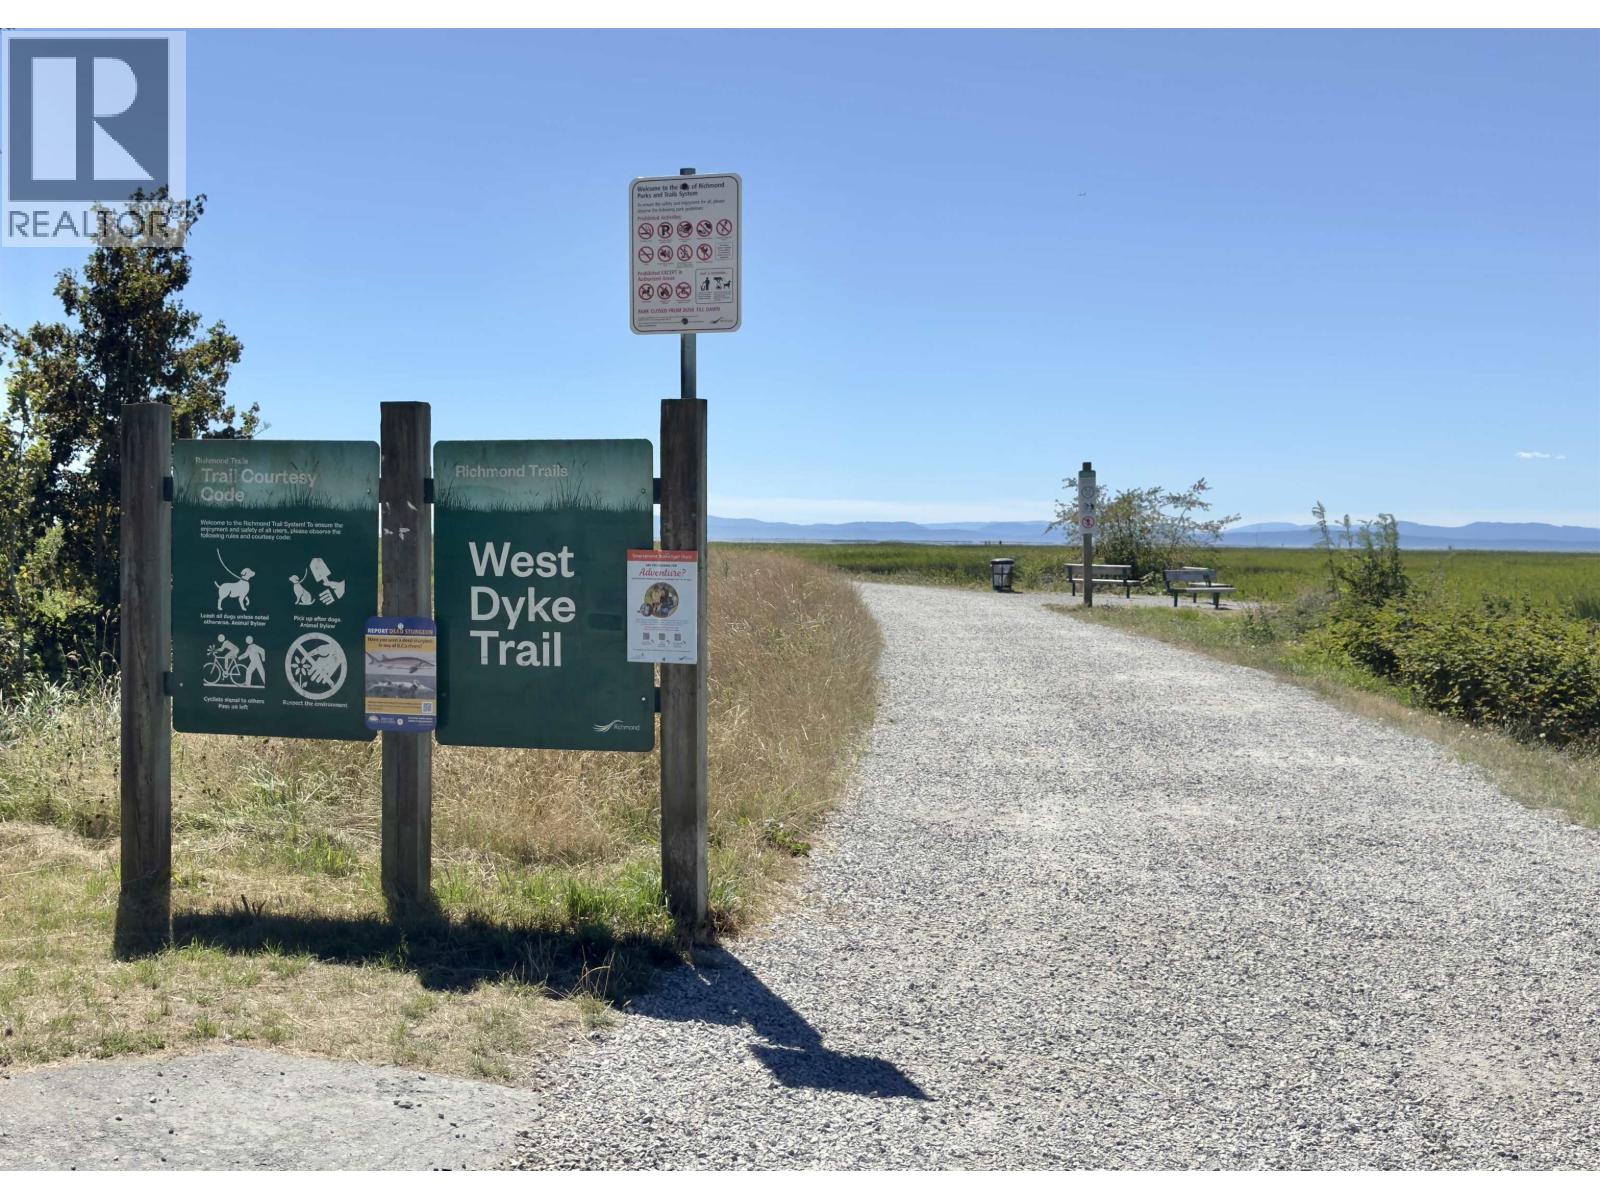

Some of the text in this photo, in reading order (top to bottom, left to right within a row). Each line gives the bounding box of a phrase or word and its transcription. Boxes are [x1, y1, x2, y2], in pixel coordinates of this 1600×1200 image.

[201, 468, 317, 488] Trail Courtesy
[455, 464, 568, 478] Richmond Trails
[200, 487, 244, 502] Code
[468, 541, 575, 578] West
[639, 568, 687, 576] Adventure?
[470, 586, 576, 630] Dyke
[470, 631, 562, 667] Trail
